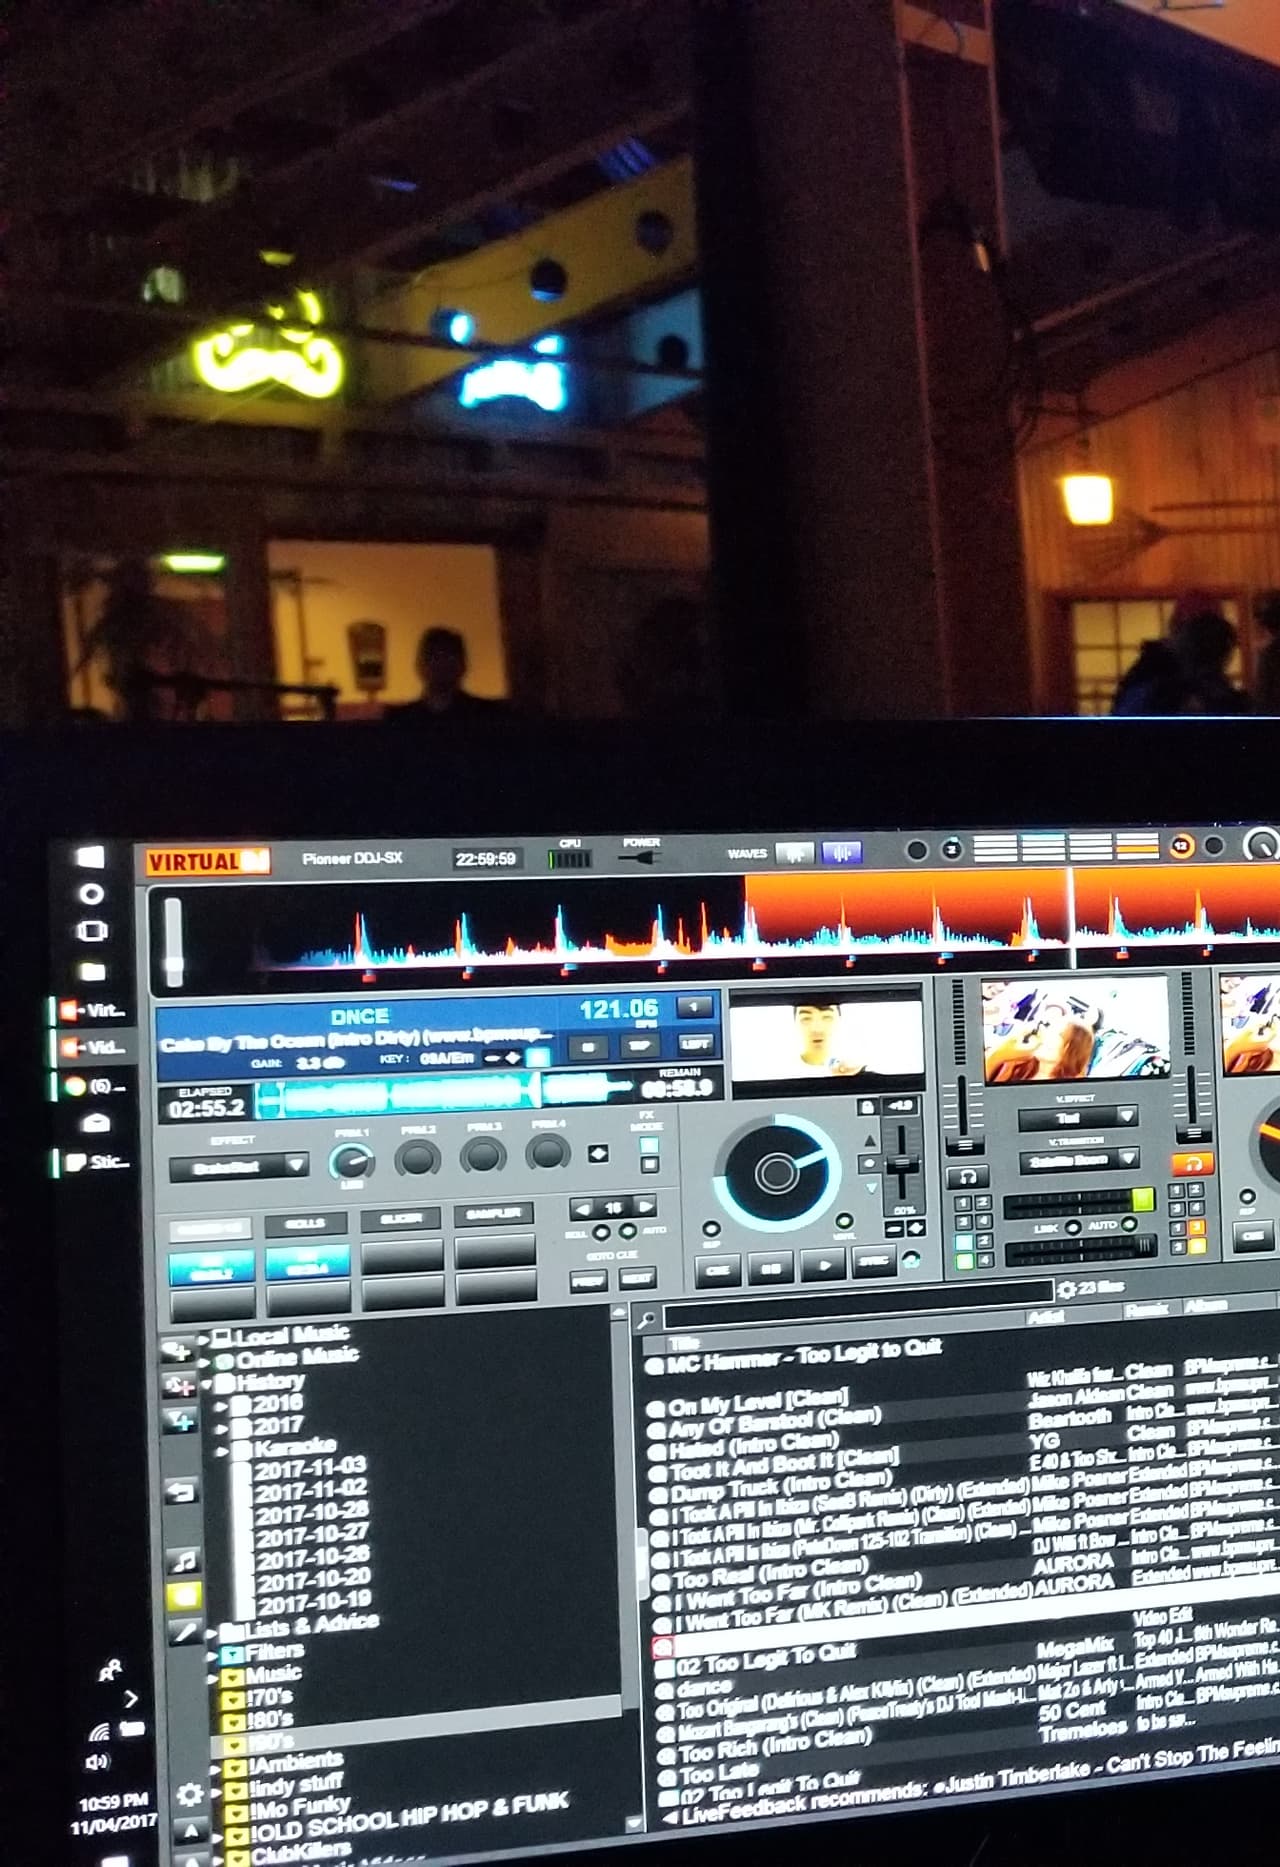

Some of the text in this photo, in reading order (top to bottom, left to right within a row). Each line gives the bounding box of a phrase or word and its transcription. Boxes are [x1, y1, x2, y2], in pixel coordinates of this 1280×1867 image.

[560, 839, 580, 848] CPU
[624, 838, 660, 848] POWER
[728, 848, 768, 859] WAVES
[150, 852, 238, 870] VIRTUAL
[303, 851, 402, 865] Pioneer DDJ-SX
[456, 852, 516, 867] 22:59:59
[331, 1008, 390, 1025] DNCE
[580, 999, 658, 1019] 121.06
[659, 1068, 701, 1077] REMAIN
[179, 1087, 232, 1097] ELAPSED
[169, 1099, 245, 1118] 02:55.2
[236, 1324, 351, 1347] Local Music
[237, 1346, 360, 1369] Online Music
[668, 1355, 700, 1374] MC
[704, 1353, 782, 1372] Hammer
[798, 1348, 831, 1364] Too
[835, 1343, 879, 1364] Legit
[882, 1342, 901, 1357] to
[904, 1338, 943, 1356] Quit
[238, 1373, 306, 1392] History
[253, 1393, 303, 1413] 2016
[669, 1386, 848, 1416] On My Level [Clean]
[253, 1415, 304, 1435] 2017
[255, 1436, 337, 1457] Karaoke
[1029, 1433, 1060, 1450] YG
[254, 1455, 367, 1481] 2017-11-03
[255, 1478, 368, 1503] 2017-11-02
[672, 1468, 893, 1504] Dump Truck (Intro Clean)
[256, 1521, 370, 1548] 2017-10-27
[1033, 1553, 1114, 1576] AURORA
[257, 1567, 371, 1593] 2017-10-20
[1033, 1573, 1115, 1596] AURORA
[258, 1589, 372, 1616] 2017-10-19
[245, 1612, 380, 1639] Lists & Advice
[246, 1643, 305, 1662] Filters
[1036, 1636, 1115, 1660] MegaMix
[676, 1642, 856, 1676] 02 Too Legit To Quit
[247, 1664, 302, 1685] Music
[247, 1688, 294, 1708] !70's
[677, 1679, 734, 1698] dance
[1038, 1702, 1107, 1723] 50 Cent
[679, 1726, 872, 1762] Too Rich (Intro Clean)
[250, 1751, 344, 1775] !Ambients
[680, 1760, 760, 1784] Too Late
[302, 1771, 344, 1792] stuff
[682, 1796, 806, 1826] LiveFeedback
[809, 1782, 928, 1809] recommends:
[945, 1771, 994, 1794] Justin
[999, 1764, 1090, 1787] Timberlake
[1107, 1755, 1150, 1775] Can't
[1154, 1749, 1194, 1772] Stop
[1198, 1743, 1229, 1763] The
[80, 1792, 148, 1812] 10:59 PM
[250, 1795, 351, 1821] !Mo Funky
[70, 1813, 158, 1835] 11/04/2017
[251, 1791, 569, 1842] !OLD SCHOOL HIP HOP & FUNK
[251, 1841, 352, 1866] ClubKillers
